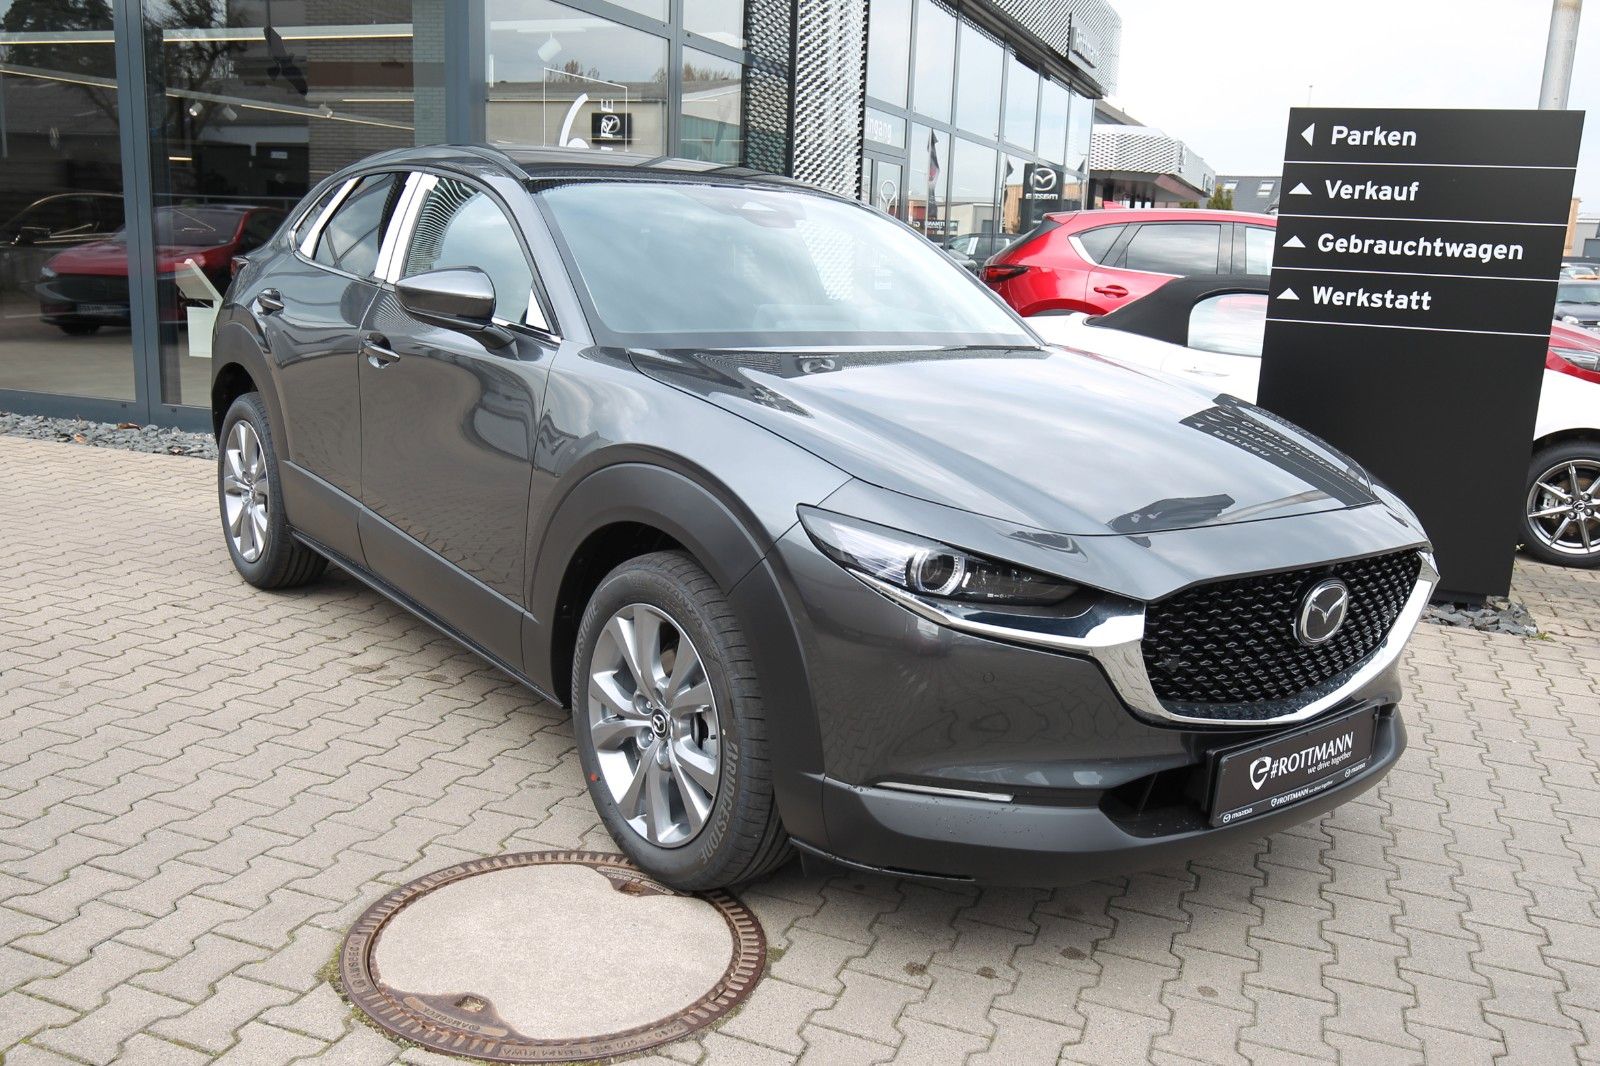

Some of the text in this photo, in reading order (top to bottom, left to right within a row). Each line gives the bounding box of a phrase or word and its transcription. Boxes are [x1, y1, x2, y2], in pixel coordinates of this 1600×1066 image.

[866, 110, 892, 145] ingang
[1331, 125, 1417, 147] Parken
[1325, 179, 1420, 202] Verkauf
[1317, 233, 1524, 264] Gebrauchtwagen
[1312, 285, 1432, 311] Werkstatt
[1307, 750, 1353, 775] we drive together
[700, 740, 739, 865] BRIDGESTONE
[1231, 807, 1253, 819] mazda
